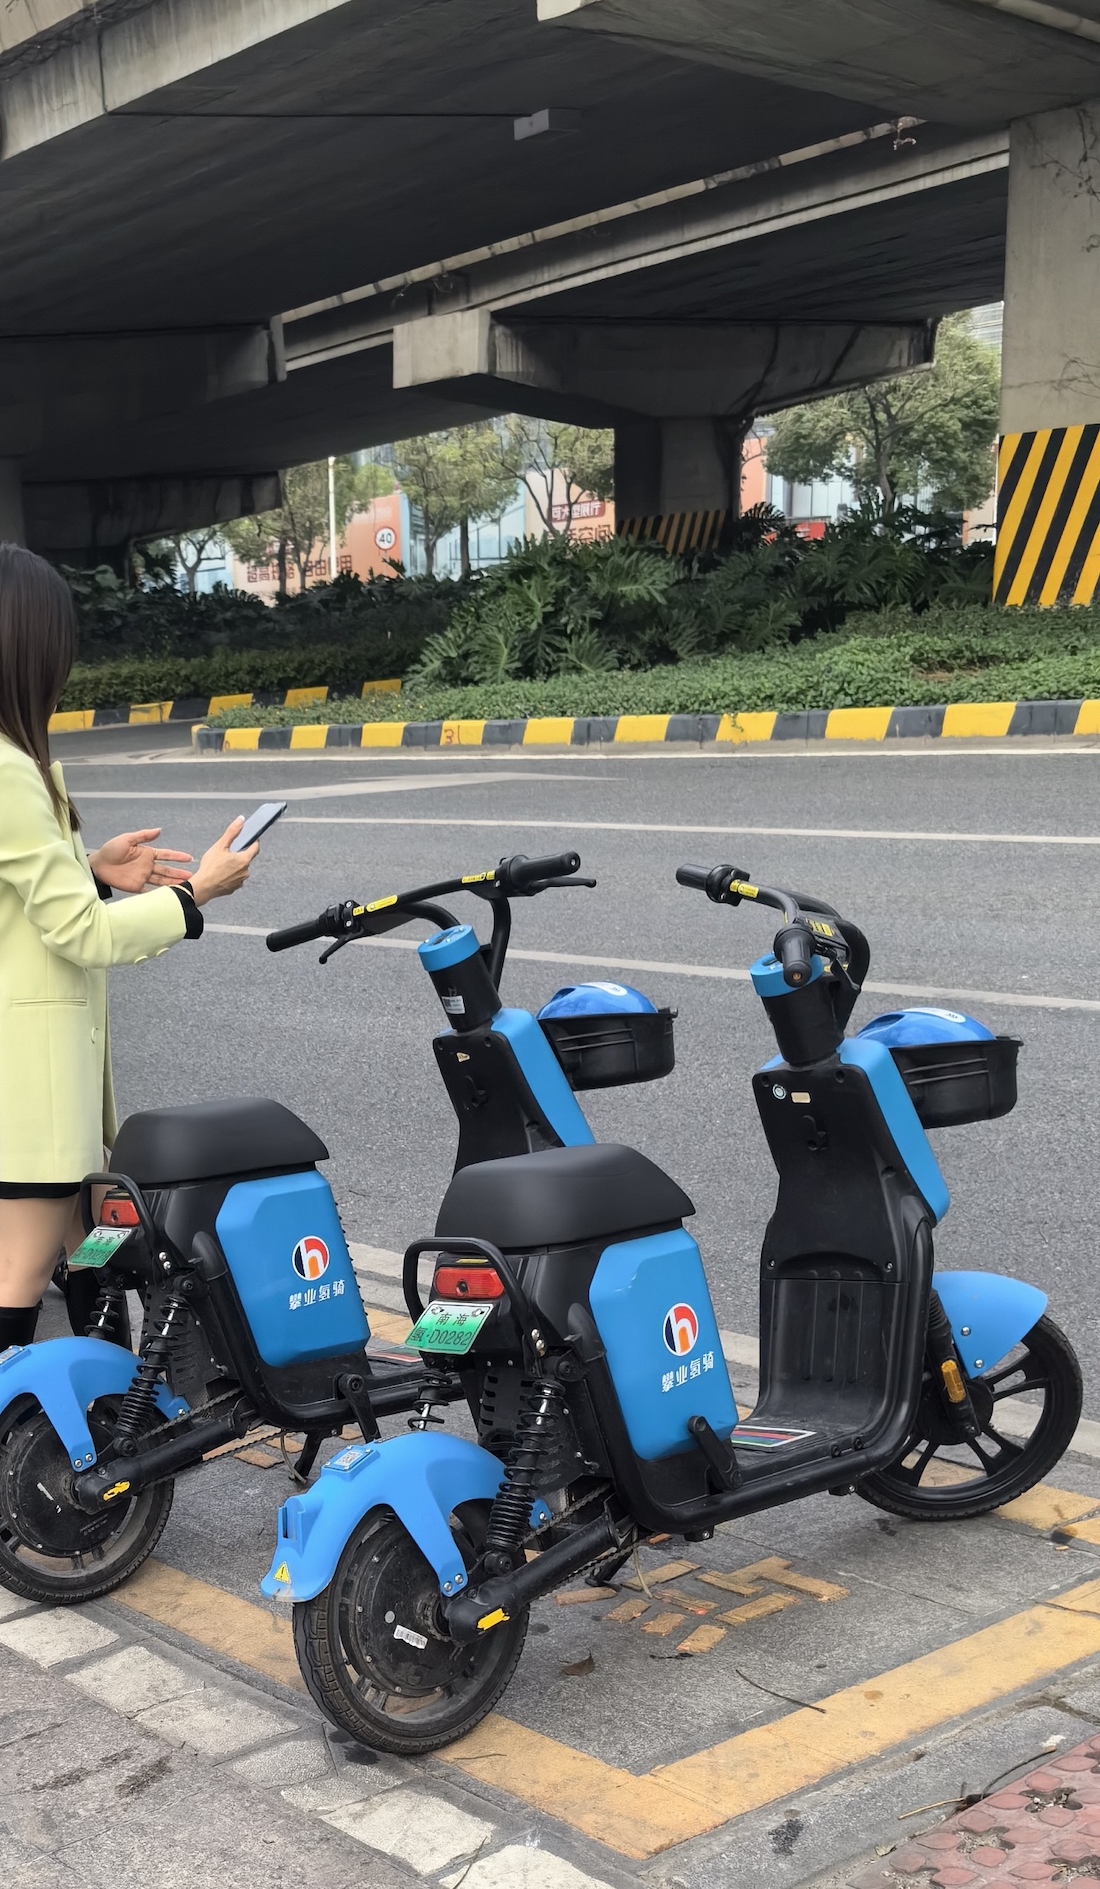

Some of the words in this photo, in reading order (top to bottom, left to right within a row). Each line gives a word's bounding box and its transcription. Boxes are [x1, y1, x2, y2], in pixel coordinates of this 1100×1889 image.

[379, 532, 393, 544] 40
[304, 554, 353, 579] 自由用
[288, 1279, 346, 1310] 攀业氢骑
[435, 1312, 471, 1326] 南海
[661, 1350, 715, 1393] 攀业氢骑
